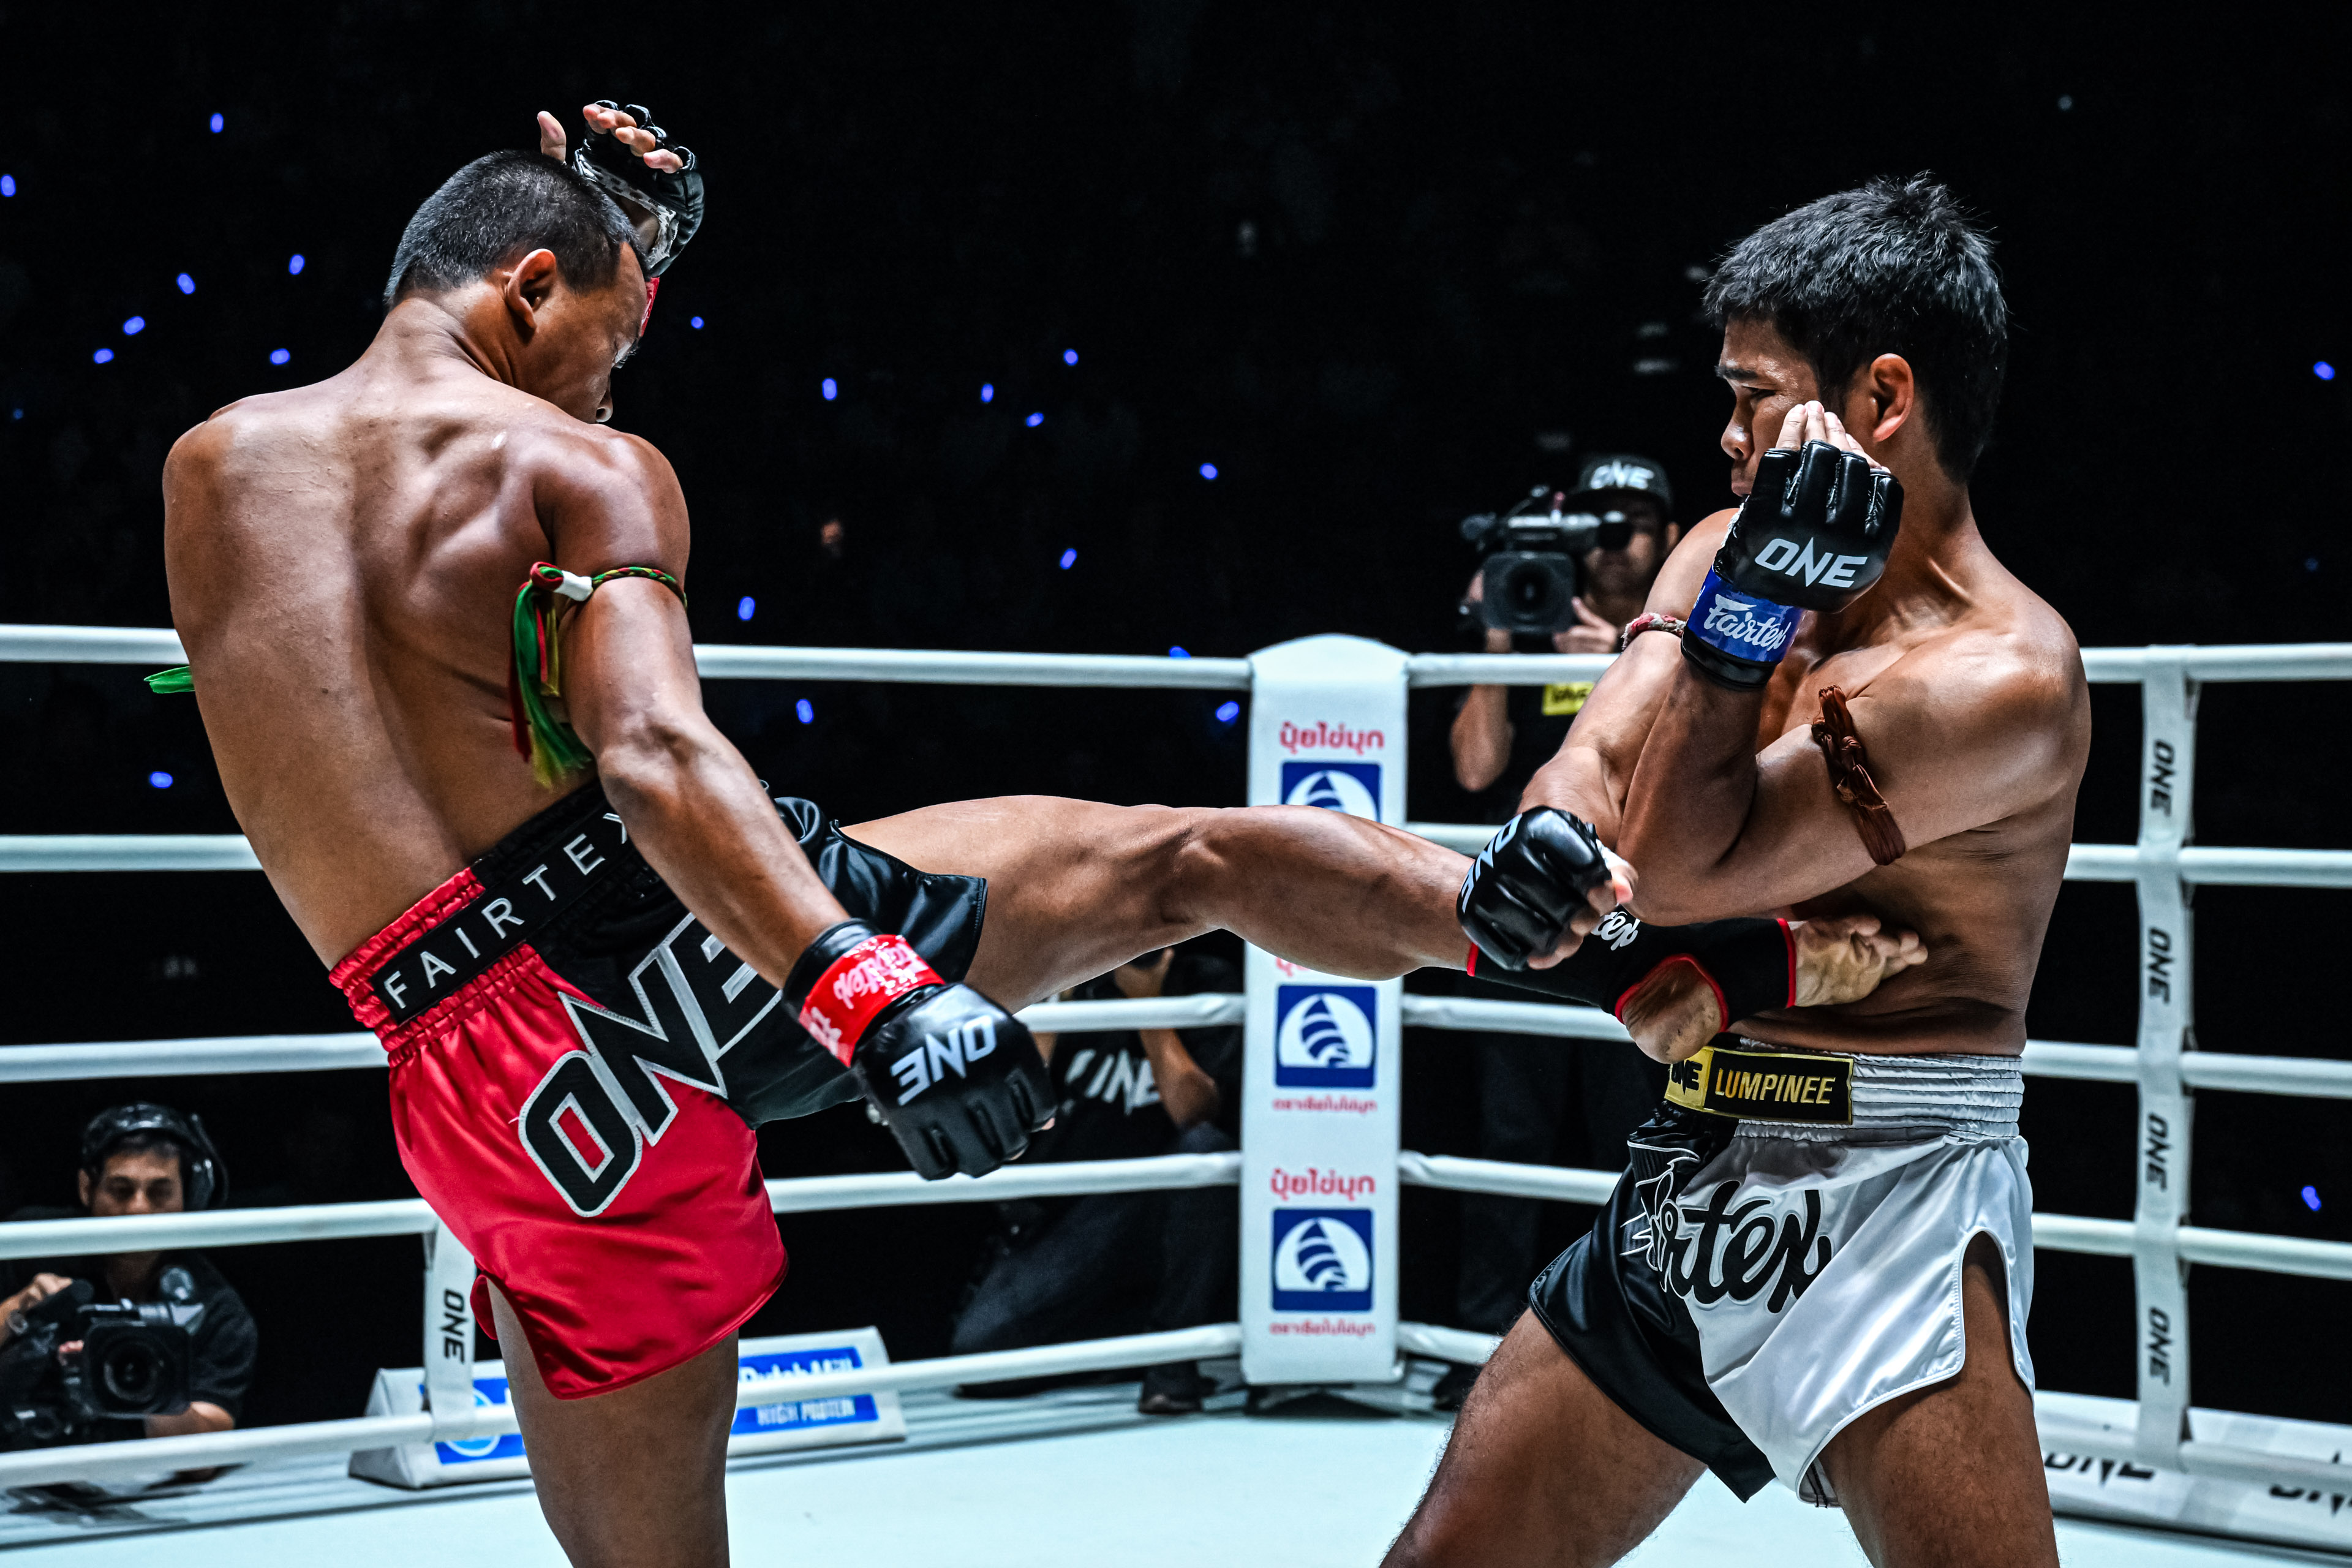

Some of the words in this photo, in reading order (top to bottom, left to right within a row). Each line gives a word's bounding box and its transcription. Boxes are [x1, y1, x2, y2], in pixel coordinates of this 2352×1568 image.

[1591, 460, 1654, 489] ONE
[1754, 537, 1868, 588] ONE
[1703, 594, 1791, 651] Fairtex
[2150, 741, 2175, 818] ONE
[2148, 927, 2174, 1004] ONE
[518, 912, 783, 1218] ONE
[889, 1014, 997, 1107] ONE
[1715, 1068, 1836, 1104] LUMPINEE
[2145, 1112, 2170, 1192] ONE
[441, 1289, 469, 1364] ONE
[2147, 1307, 2172, 1387] ONE
